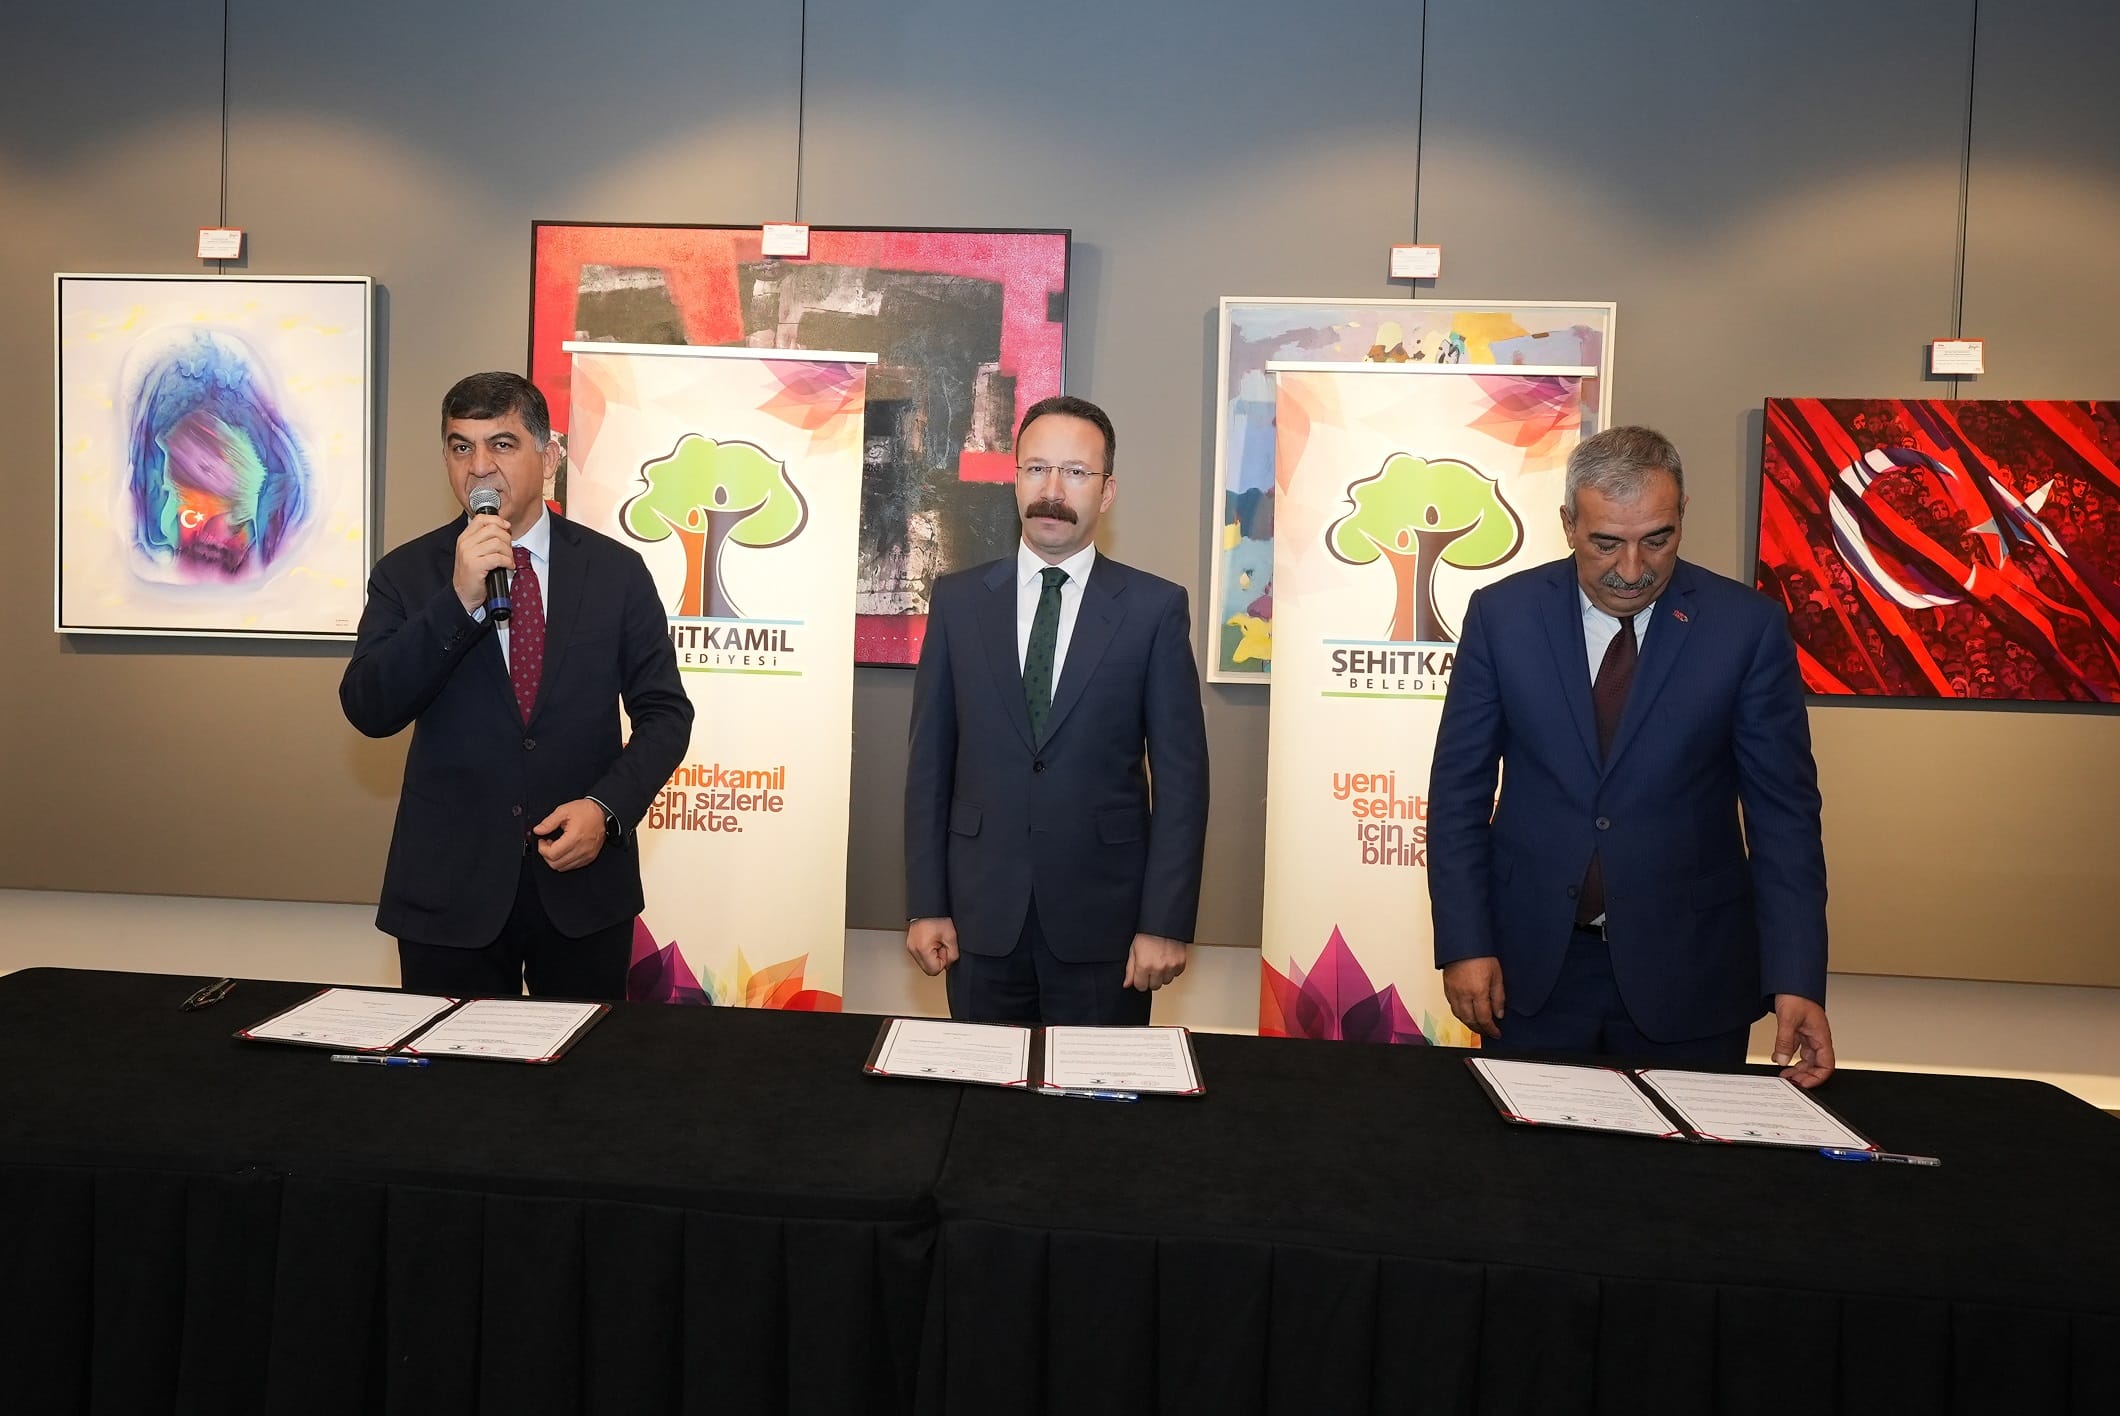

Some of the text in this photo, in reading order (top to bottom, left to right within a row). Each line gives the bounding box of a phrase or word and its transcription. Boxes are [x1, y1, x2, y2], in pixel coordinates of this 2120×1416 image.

[668, 626, 794, 652] iTKAMiL
[685, 653, 777, 666] EDiYESi
[1331, 649, 1455, 676] ŞEHiTKA
[1350, 678, 1449, 690] BELEDi
[665, 763, 785, 790] hitkamil
[1333, 770, 1395, 800] yeni
[695, 788, 783, 812] sizlerle
[648, 806, 743, 833] birlikte.
[1362, 842, 1426, 867] birlik
